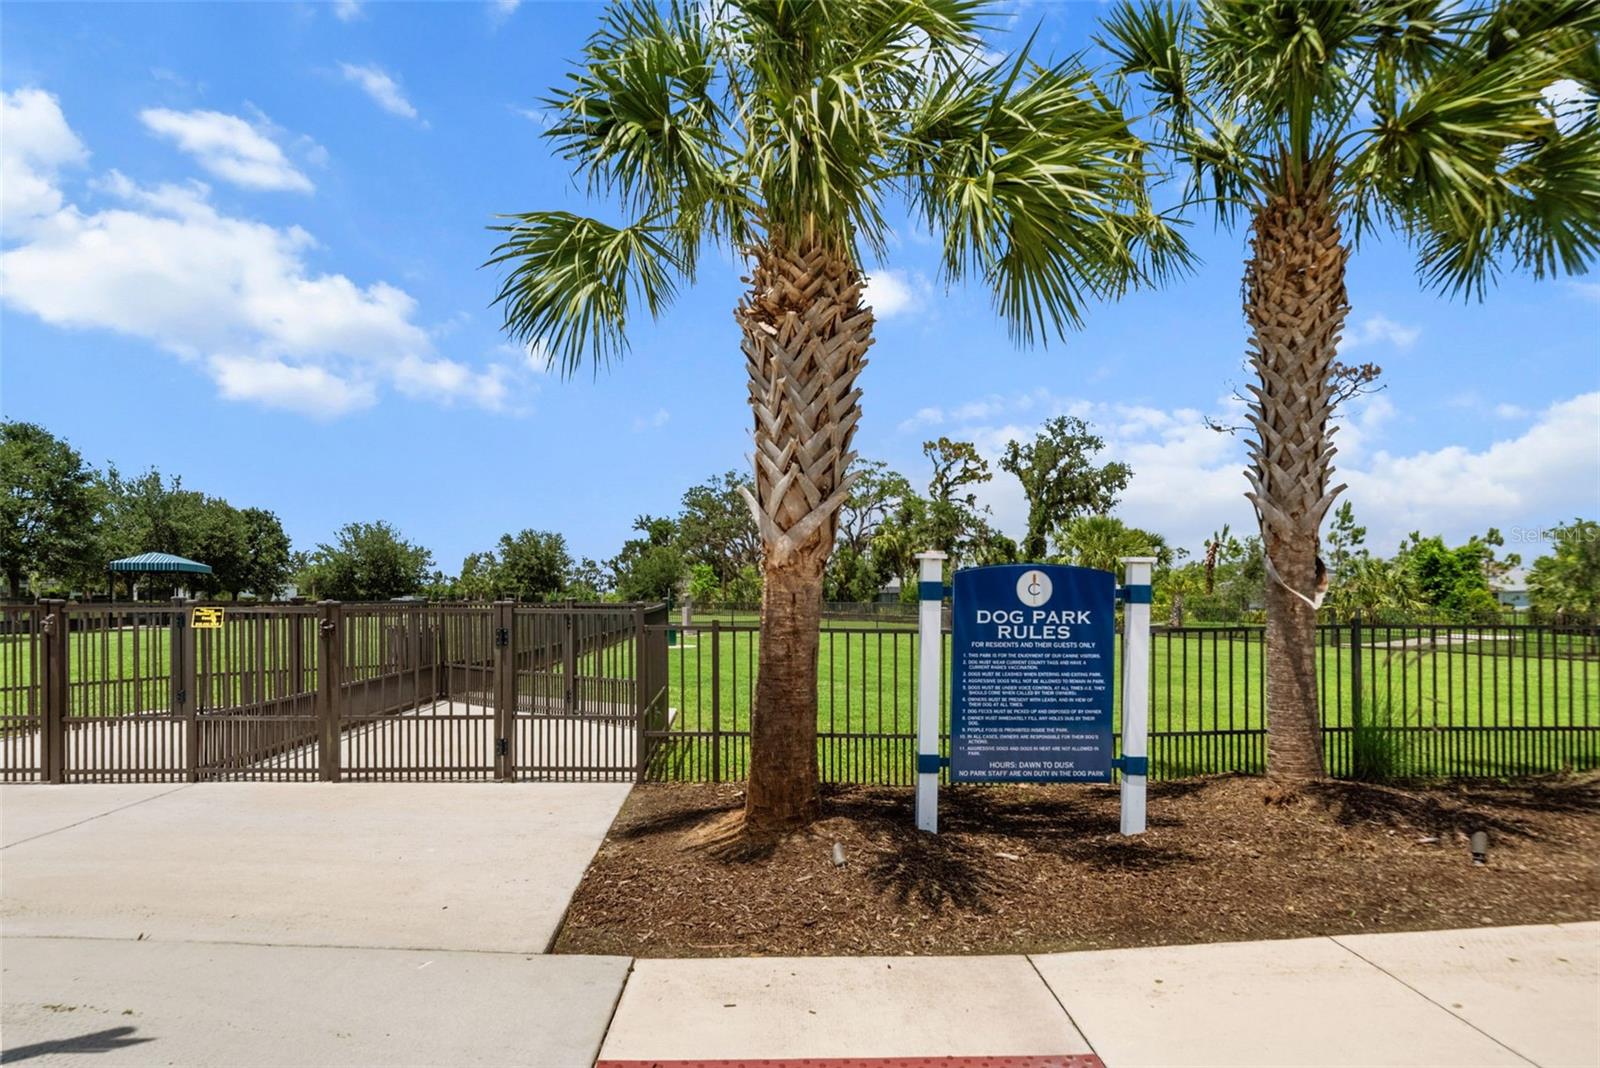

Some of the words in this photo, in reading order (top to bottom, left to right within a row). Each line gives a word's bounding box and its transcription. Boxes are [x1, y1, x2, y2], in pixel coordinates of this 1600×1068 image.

[977, 610, 1024, 624] DOG
[1032, 610, 1091, 624] PARK
[998, 626, 1070, 639] RULES
